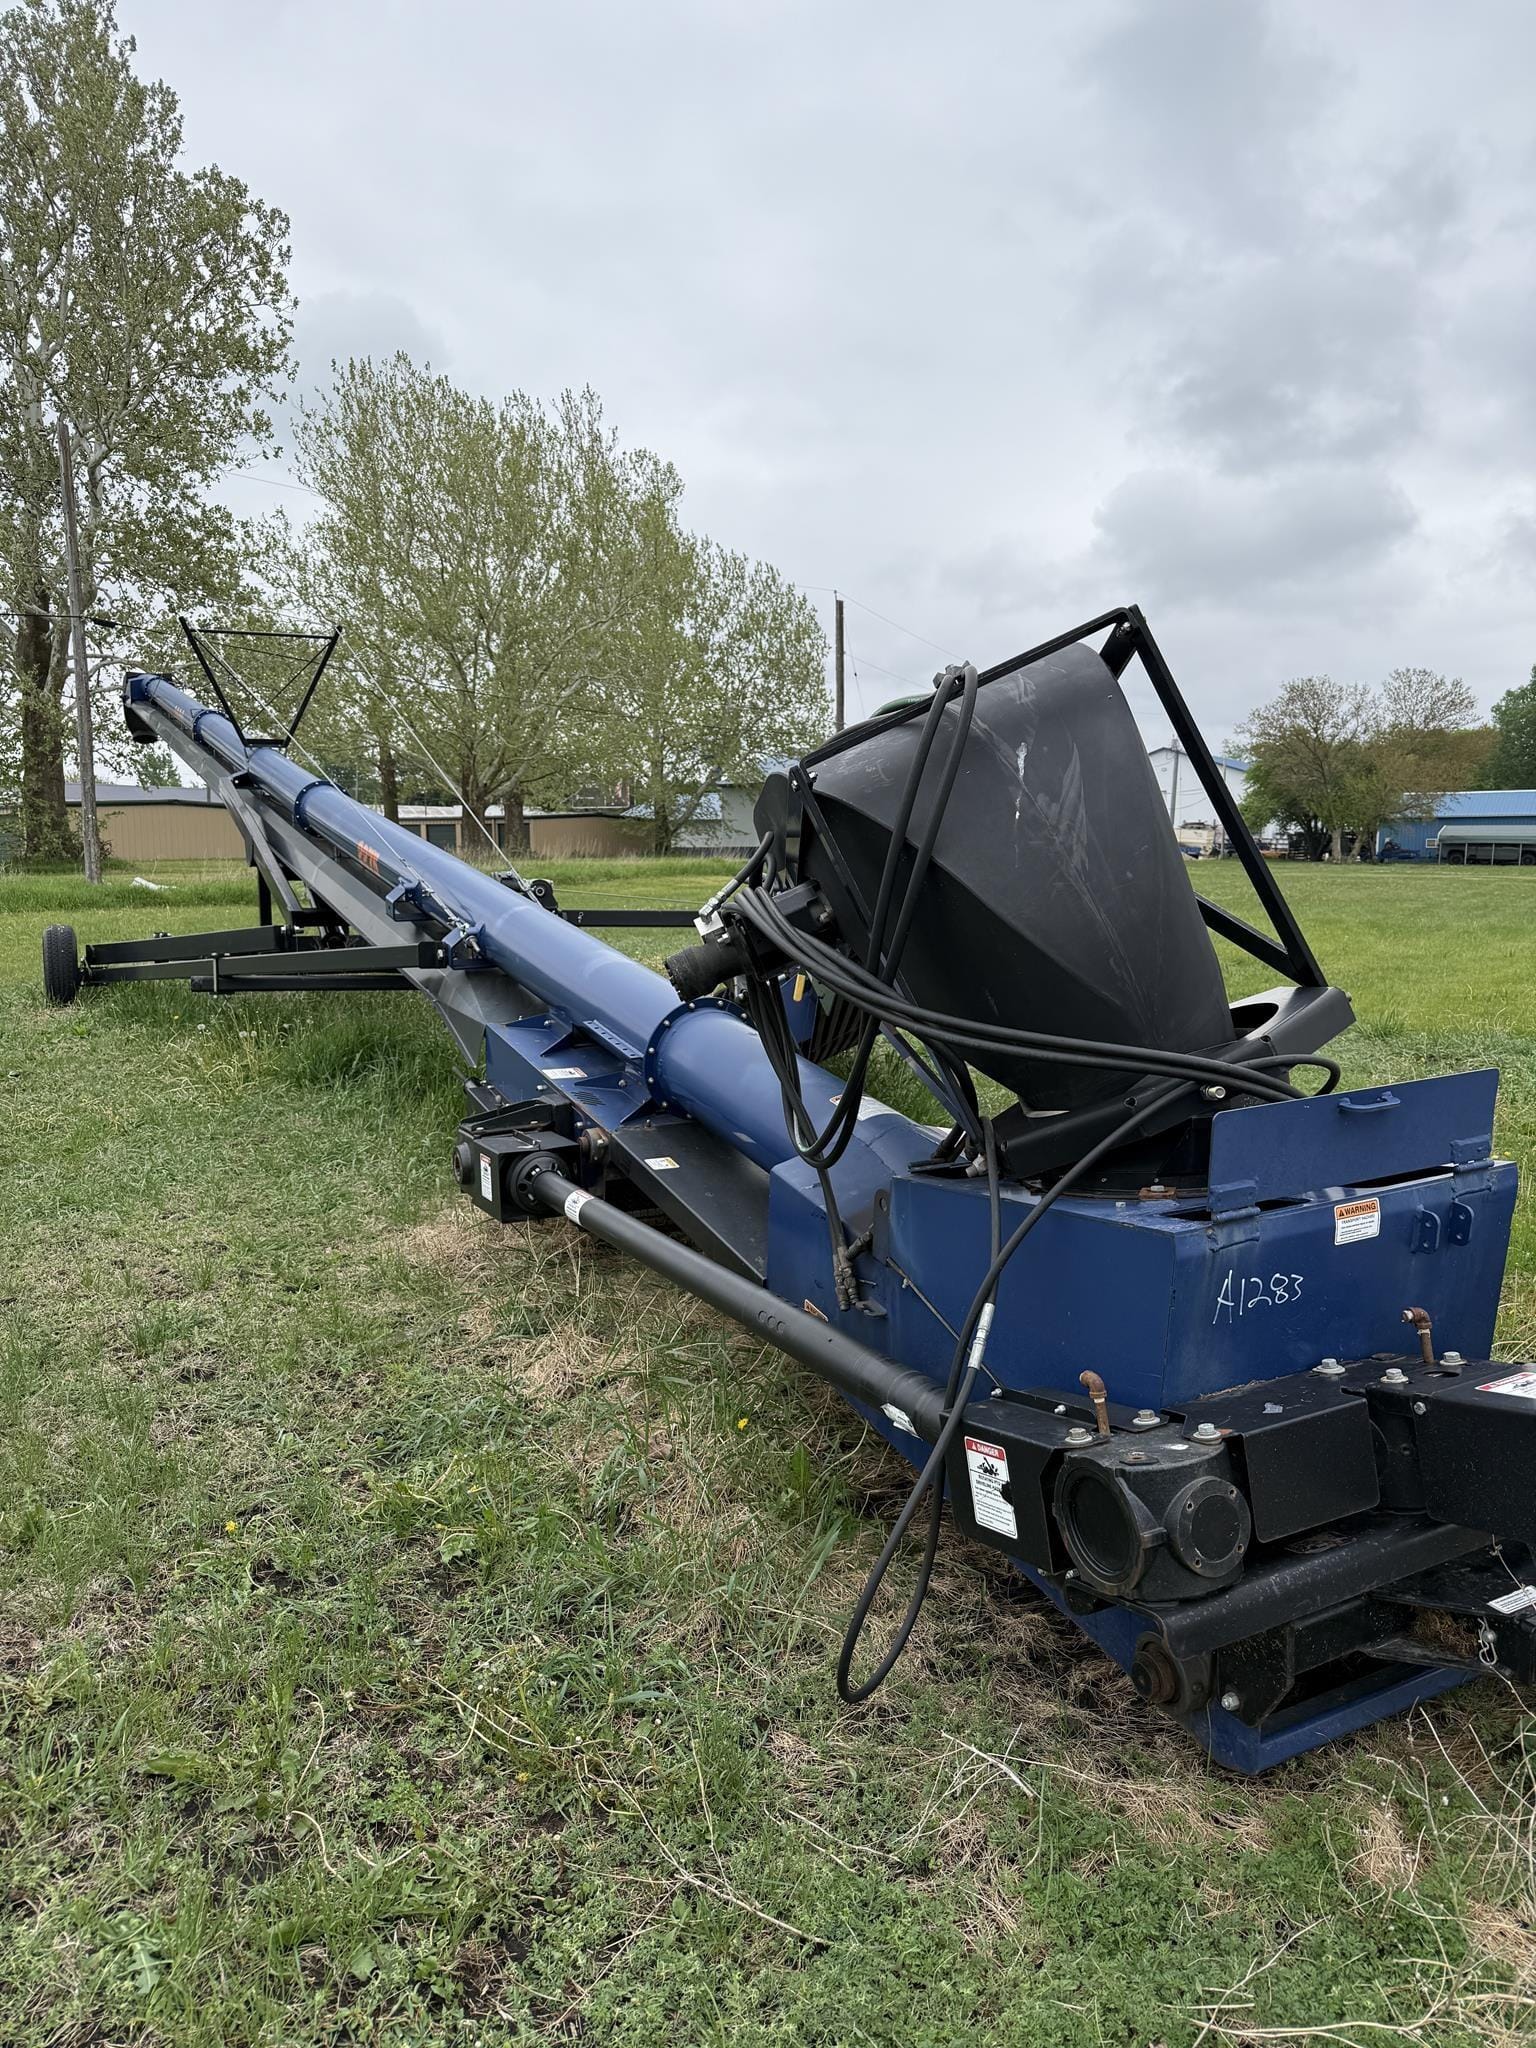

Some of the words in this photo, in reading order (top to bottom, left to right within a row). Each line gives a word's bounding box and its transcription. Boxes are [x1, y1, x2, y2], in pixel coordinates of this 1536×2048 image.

[1344, 1202, 1376, 1215] WARNING
[1212, 1269, 1304, 1325] A1283
[977, 1443, 999, 1457] DANGER
